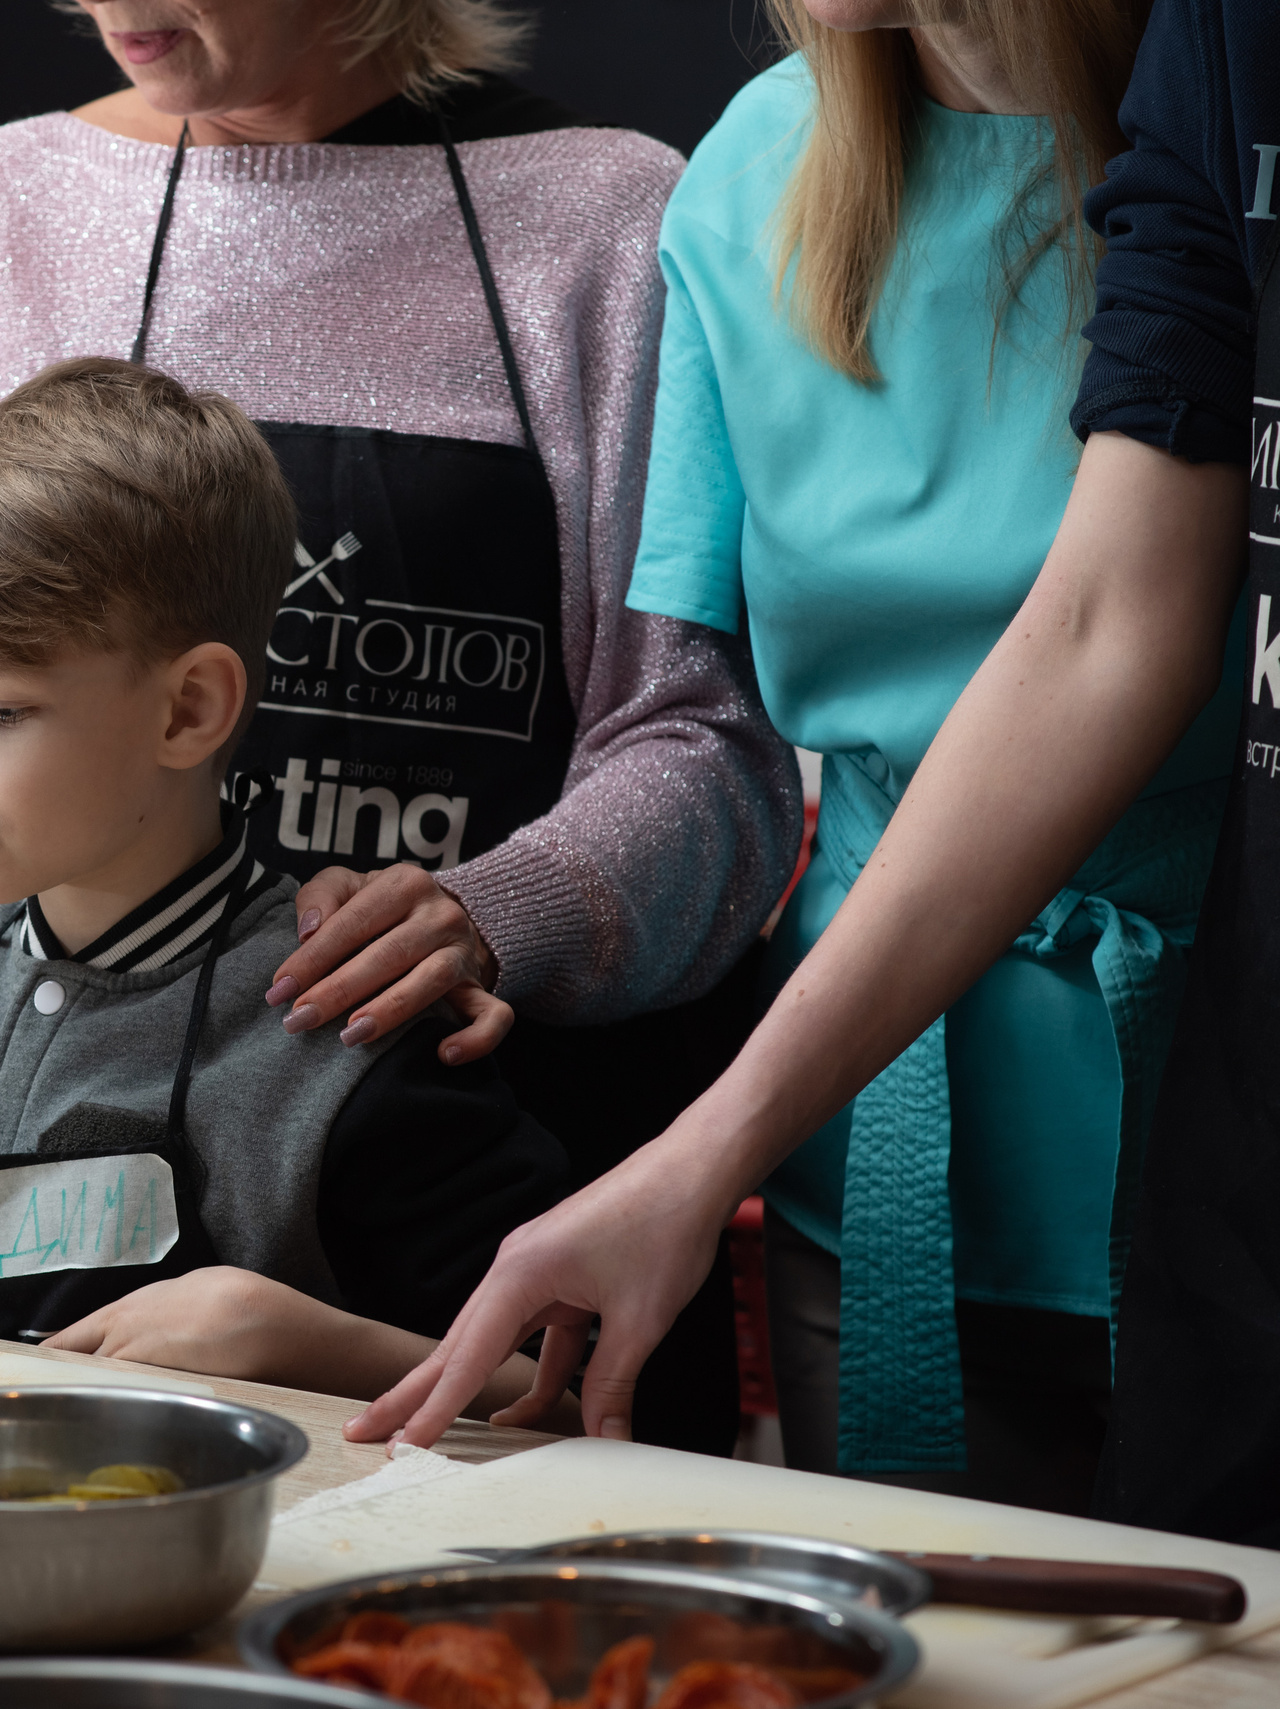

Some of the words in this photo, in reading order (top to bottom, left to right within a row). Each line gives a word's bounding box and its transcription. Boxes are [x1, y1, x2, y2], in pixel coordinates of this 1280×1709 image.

[266, 606, 531, 693] СТОЛОВ
[345, 683, 458, 713] СТУДИЯ
[342, 758, 397, 782] since
[406, 763, 454, 788] 1889
[231, 756, 470, 873] ting
